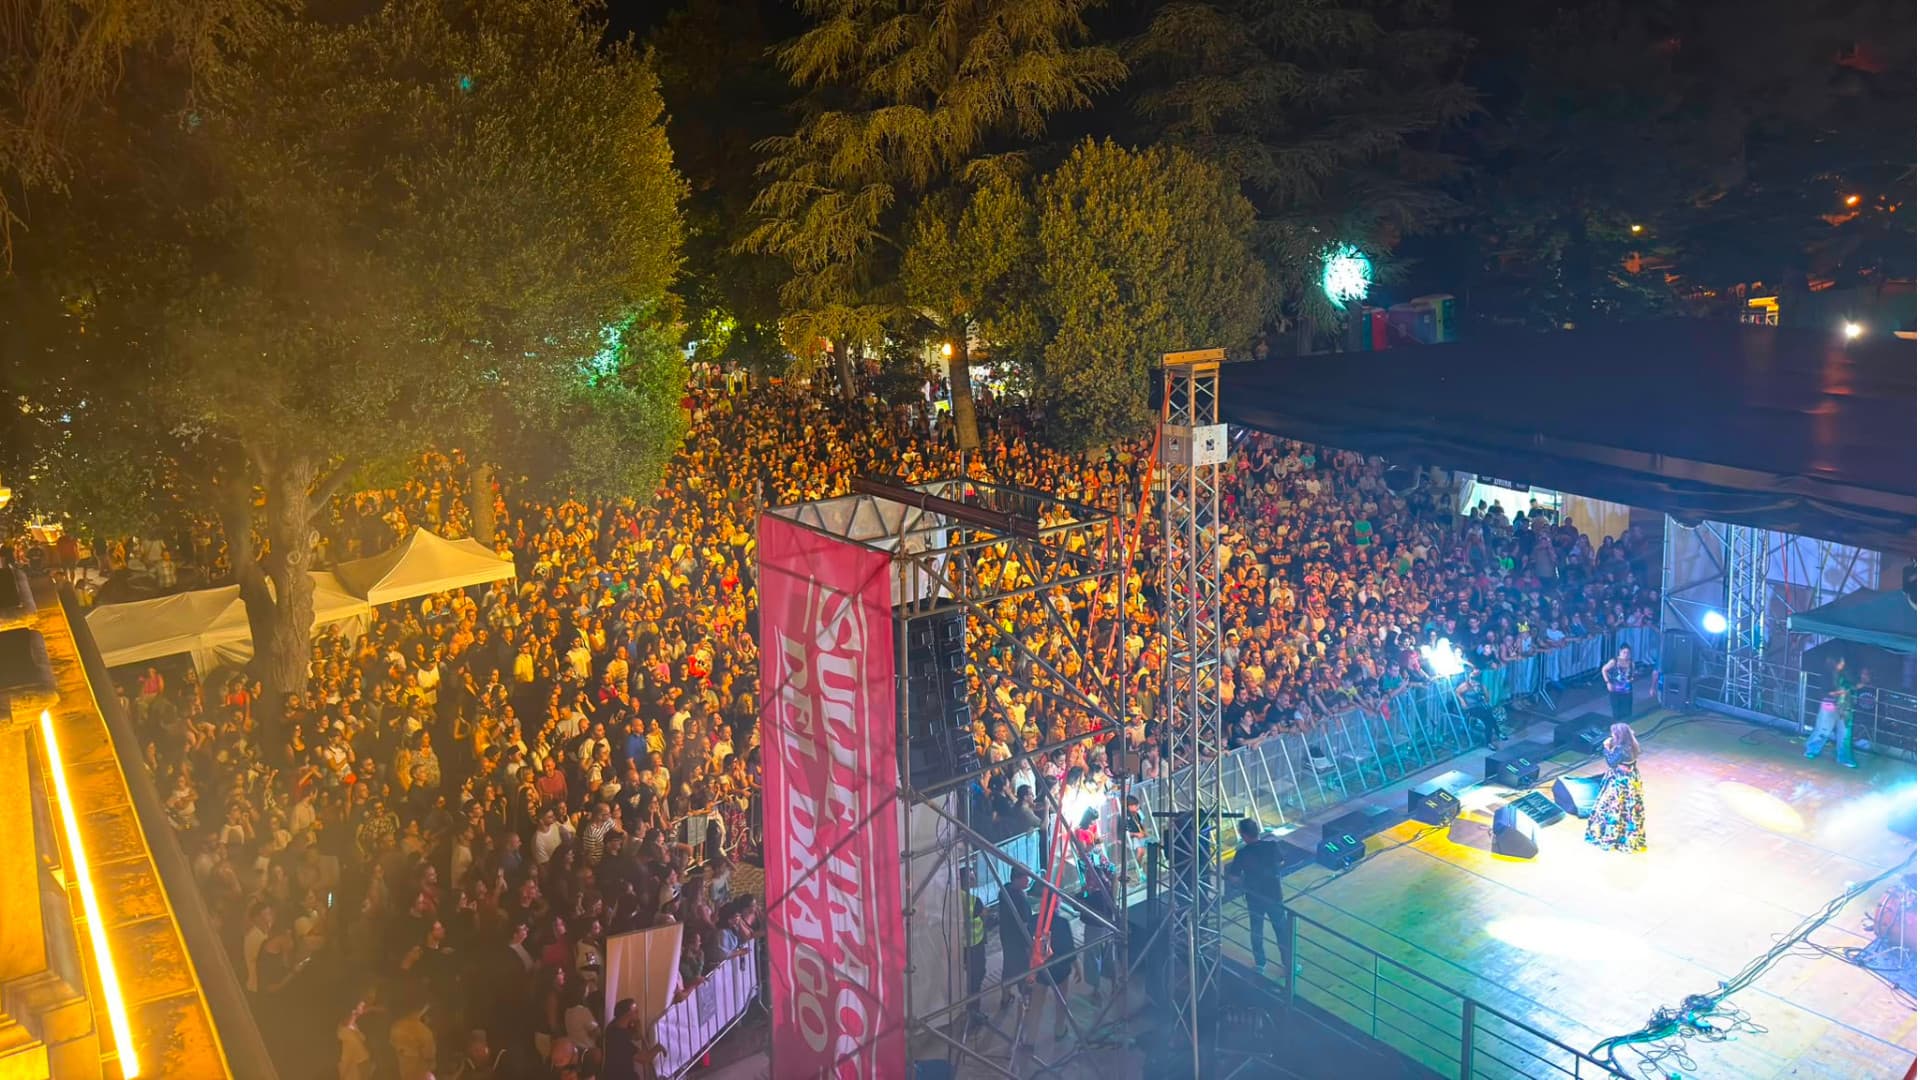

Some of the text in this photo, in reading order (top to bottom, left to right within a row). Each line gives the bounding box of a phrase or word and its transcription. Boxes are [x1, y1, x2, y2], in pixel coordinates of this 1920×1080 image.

[779, 628, 829, 1053] DEL DRAGO
[815, 583, 862, 833] SULLE
